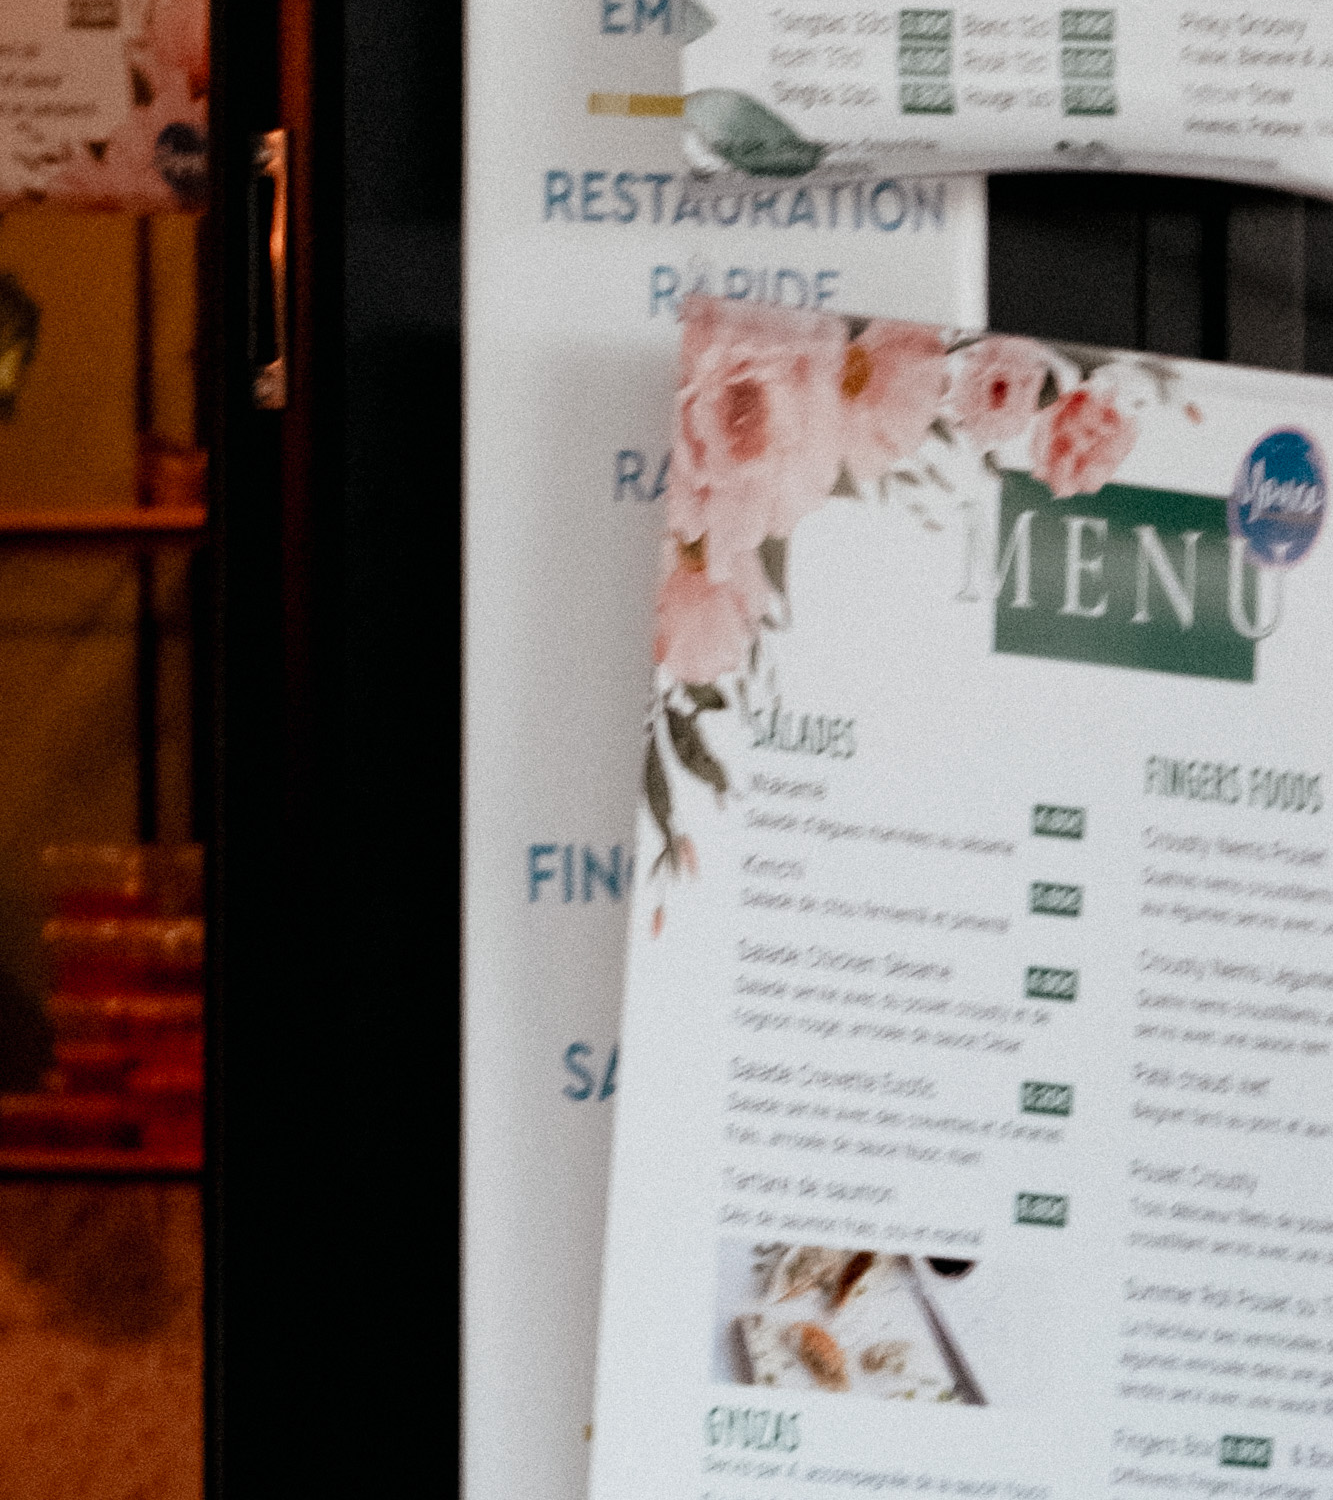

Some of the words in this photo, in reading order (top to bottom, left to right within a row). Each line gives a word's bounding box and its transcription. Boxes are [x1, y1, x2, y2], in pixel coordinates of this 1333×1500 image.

[543, 170, 946, 233] RESTAURATION
[955, 490, 1285, 640] MENU
[751, 706, 855, 760] SALADES
[1143, 756, 1241, 805] FINGERS
[1248, 765, 1324, 815] FOODS
[527, 844, 634, 904] FIN
[706, 1406, 799, 1452] GYOZAS
